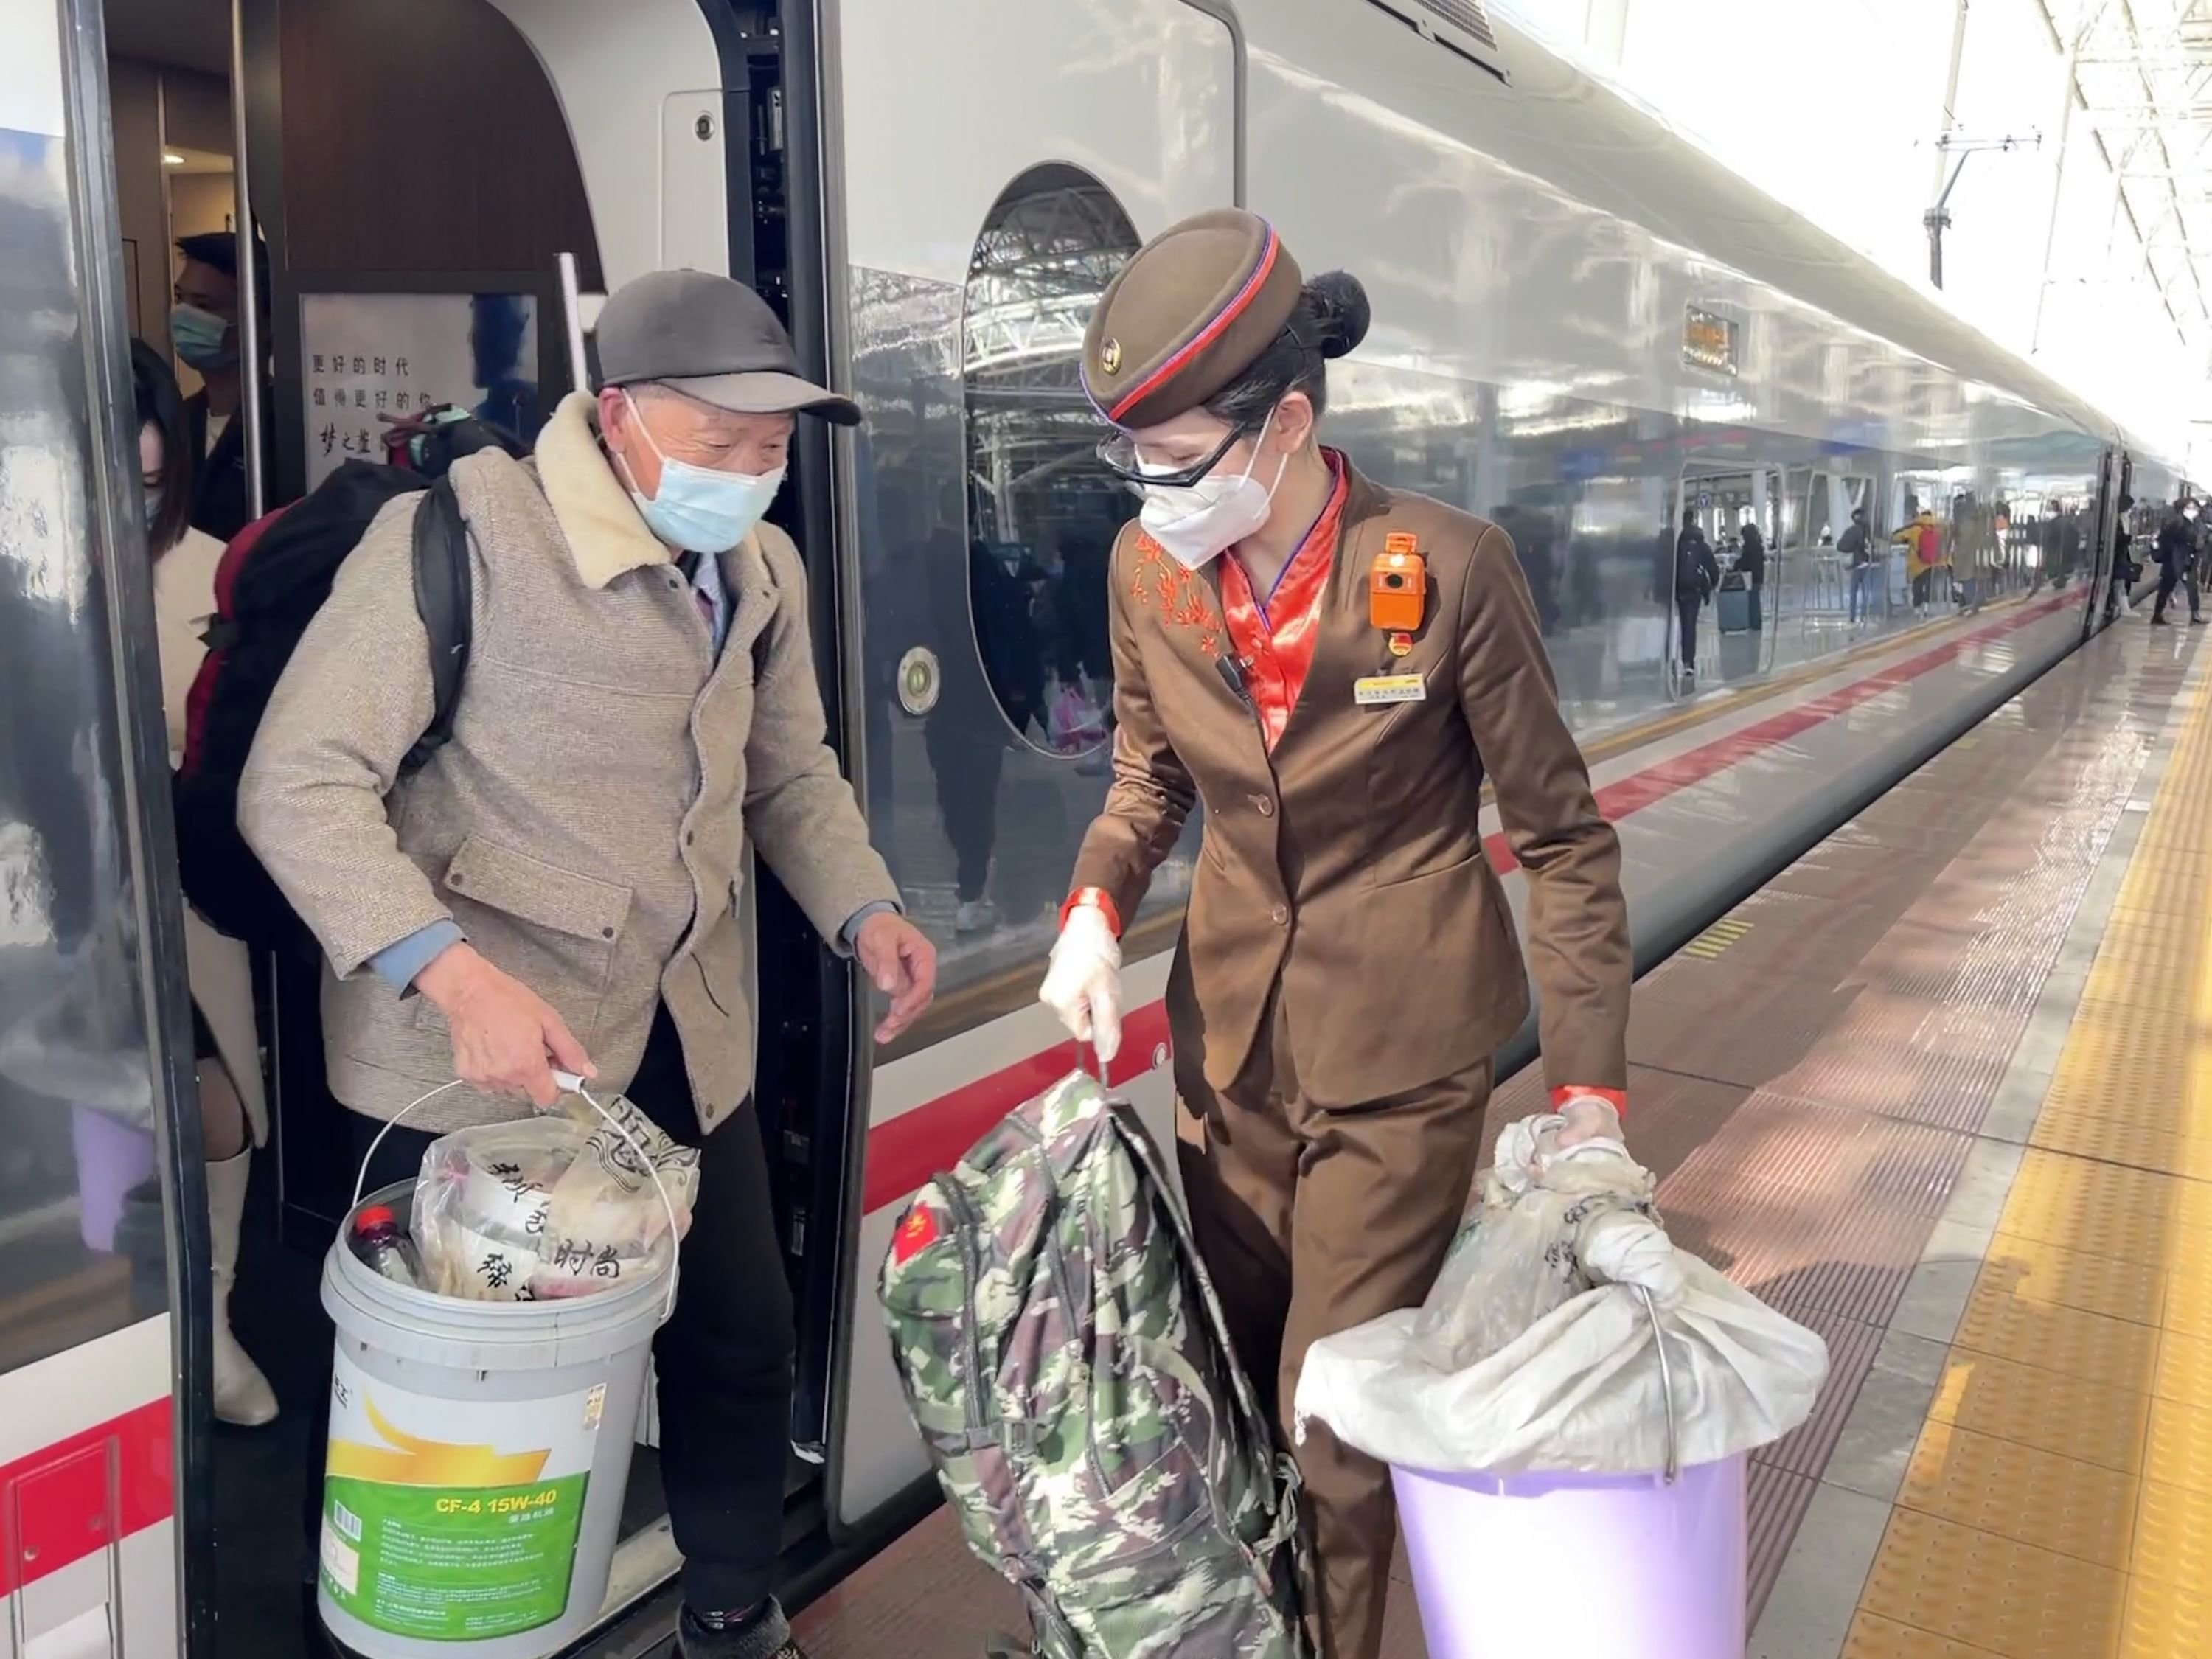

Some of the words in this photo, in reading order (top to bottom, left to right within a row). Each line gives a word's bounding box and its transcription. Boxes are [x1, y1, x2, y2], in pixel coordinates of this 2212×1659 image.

[313, 355, 409, 376] 更好的时代
[554, 1238, 620, 1279] 时尚
[435, 1498, 481, 1513] CF-4
[487, 1489, 557, 1514] 15W-40
